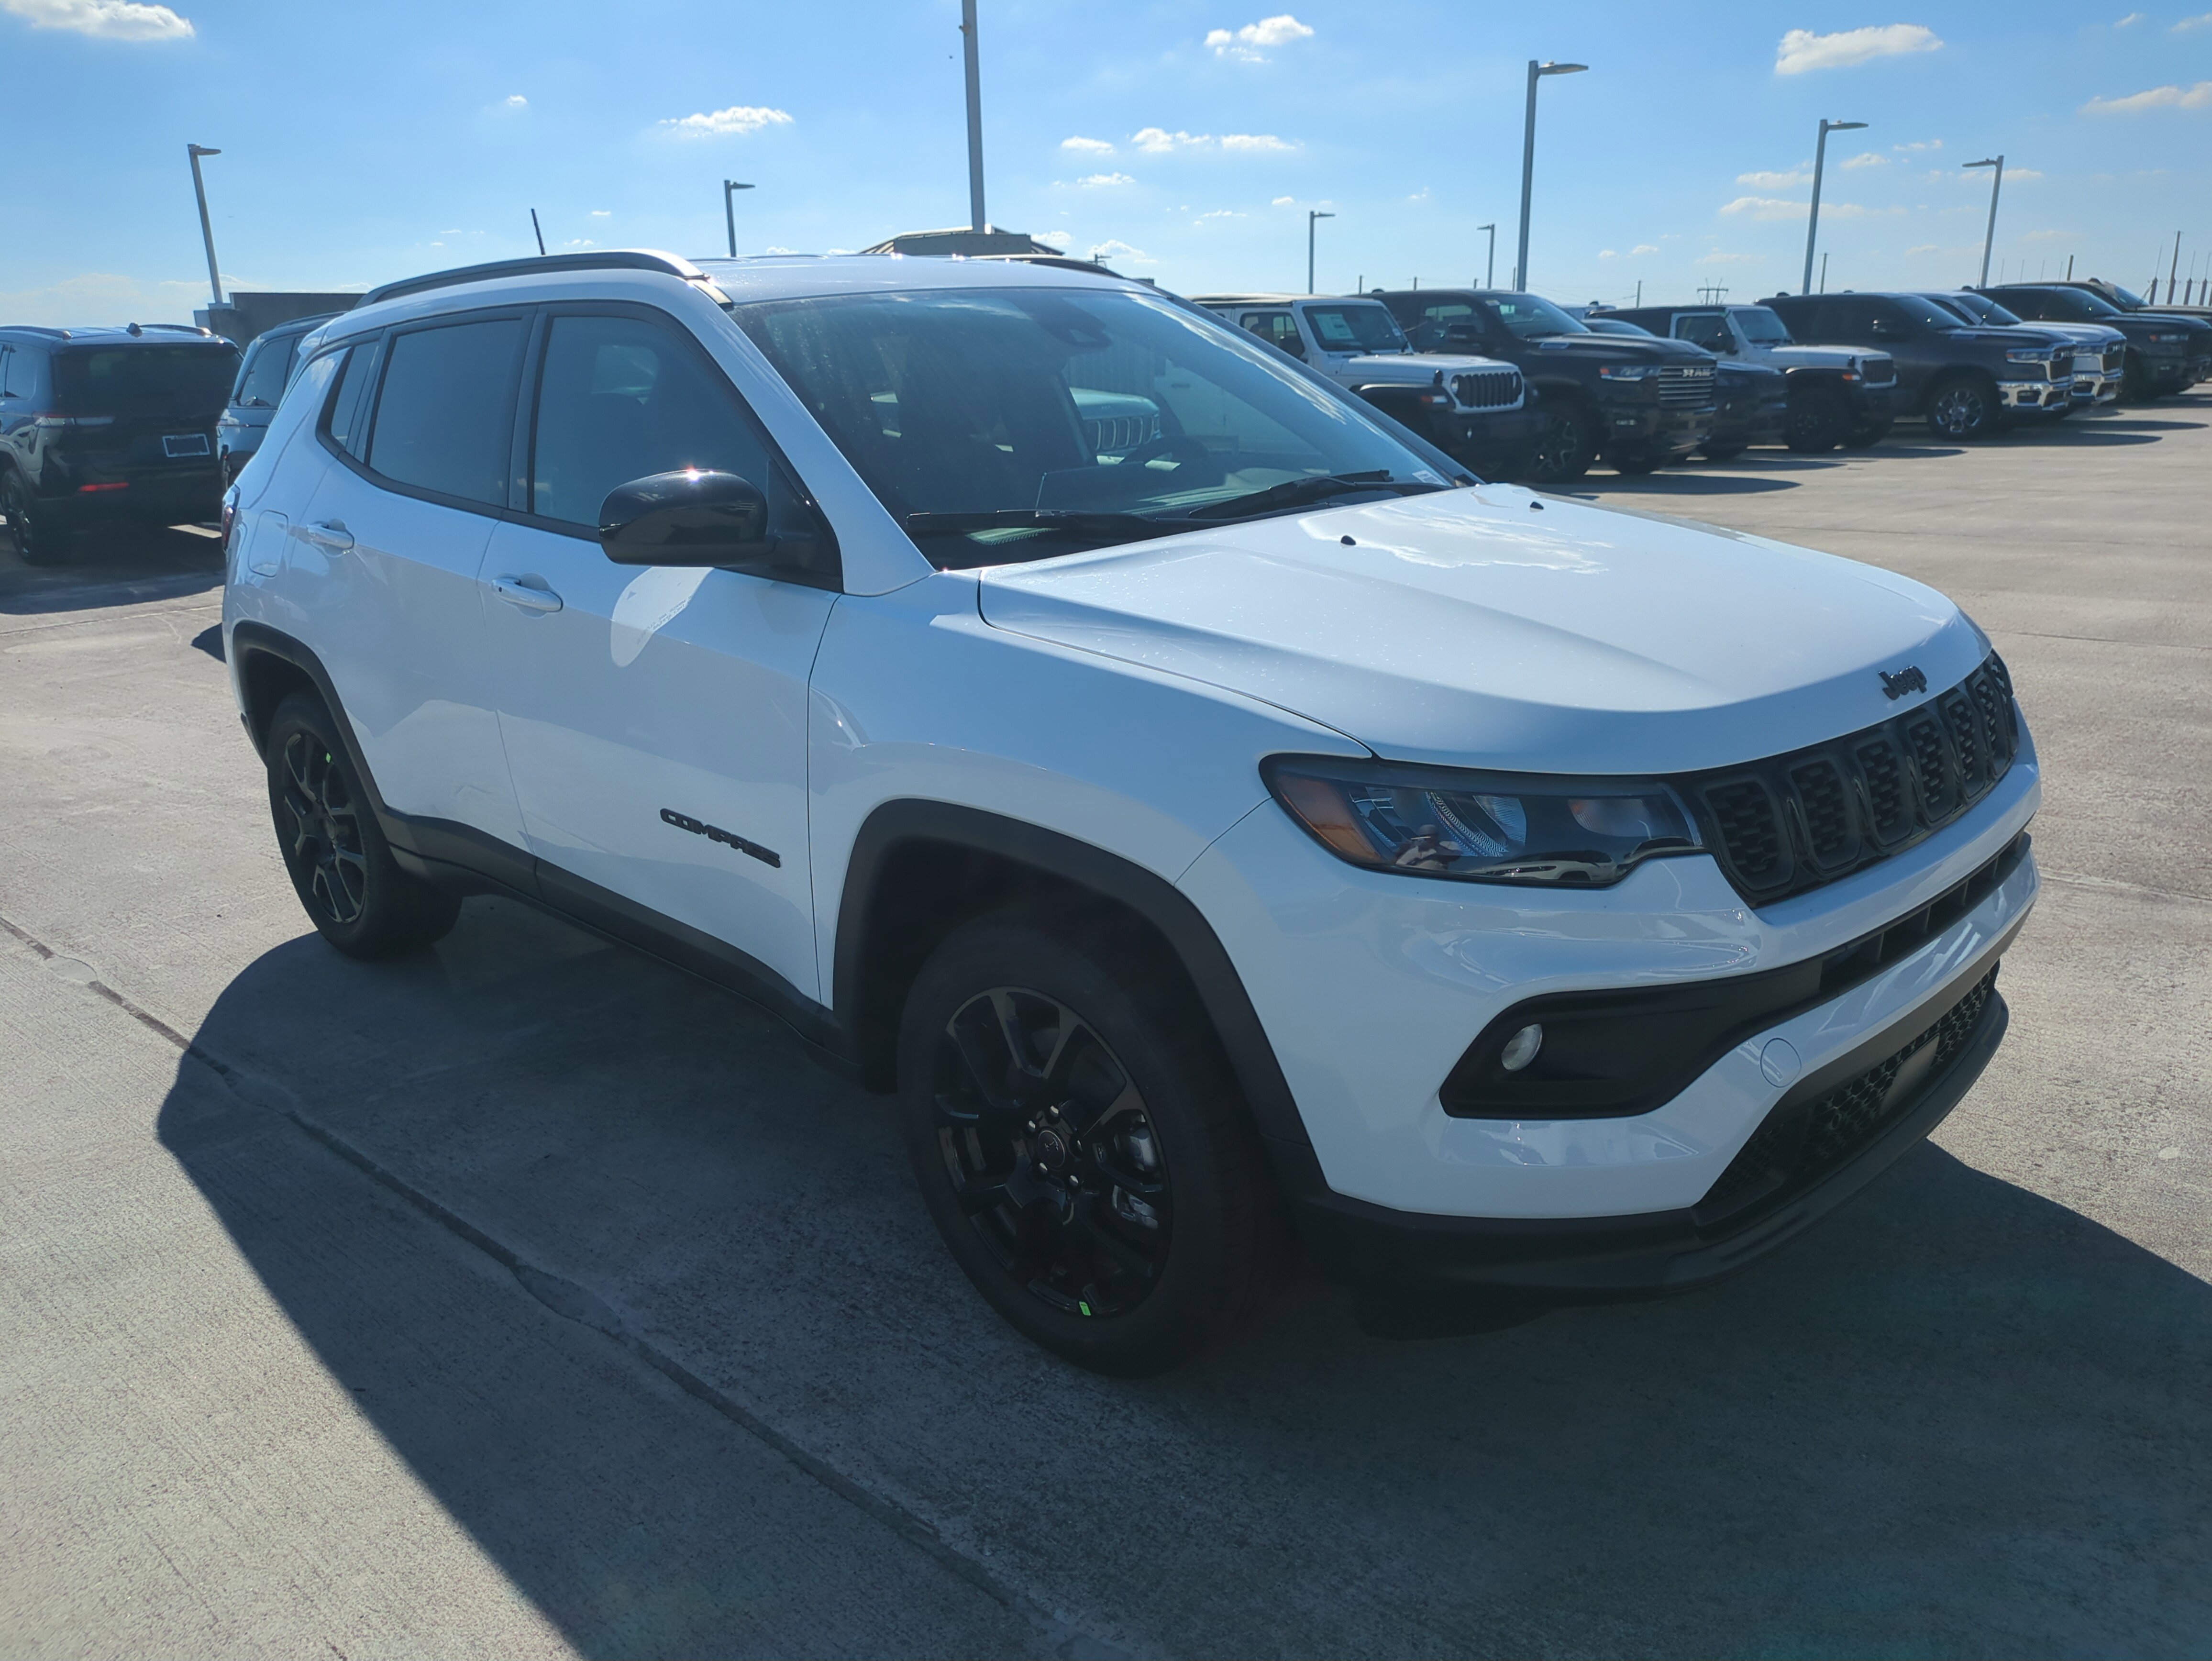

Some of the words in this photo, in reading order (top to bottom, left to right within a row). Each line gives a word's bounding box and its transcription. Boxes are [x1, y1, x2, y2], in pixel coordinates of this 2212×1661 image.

[1682, 368, 1711, 377] RAM
[1878, 665, 1927, 700] Jeep
[660, 808, 781, 868] COMPASS
